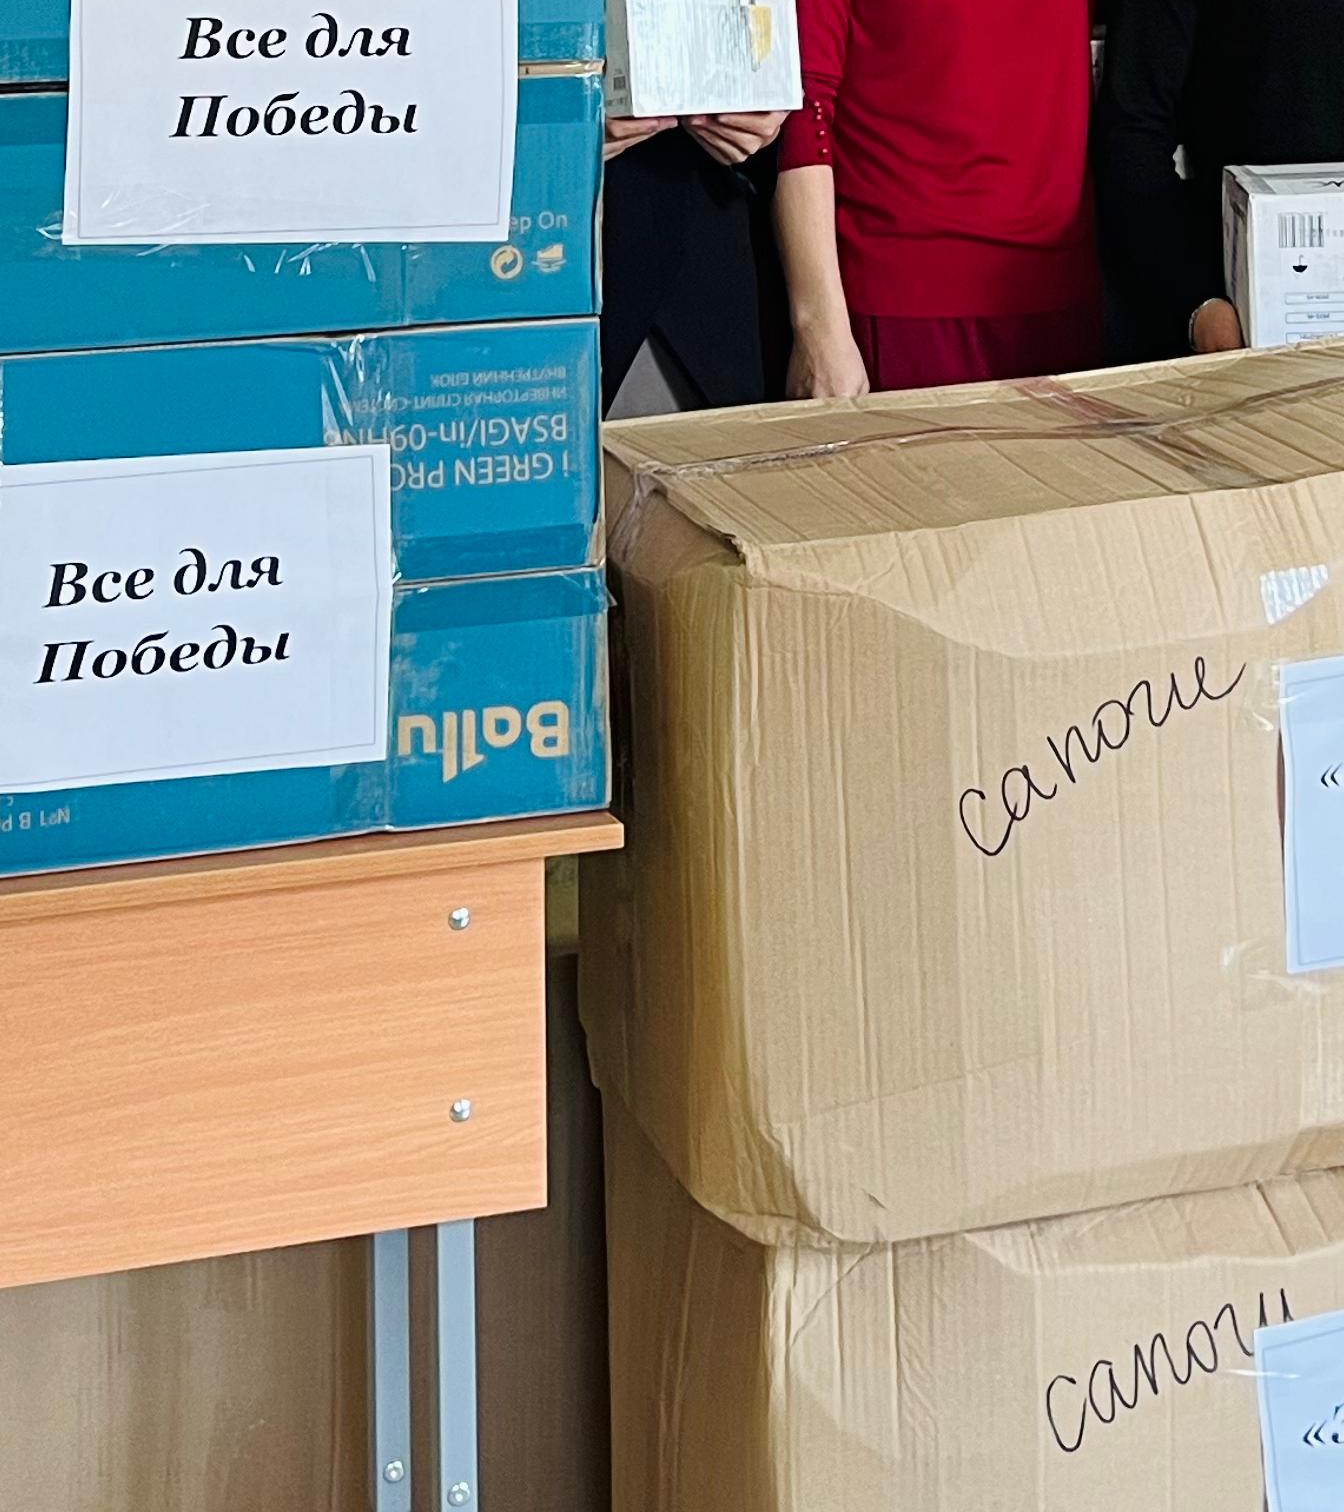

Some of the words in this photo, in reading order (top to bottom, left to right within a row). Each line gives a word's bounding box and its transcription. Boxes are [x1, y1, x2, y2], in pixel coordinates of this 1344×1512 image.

[179, 15, 287, 61] Все
[305, 11, 412, 57] для
[169, 88, 419, 139] Победы
[538, 210, 568, 229] On
[455, 451, 553, 486] GREEN
[42, 560, 155, 610] Все
[172, 547, 284, 596] для
[32, 623, 291, 685] Победы
[397, 700, 571, 784] Ballu
